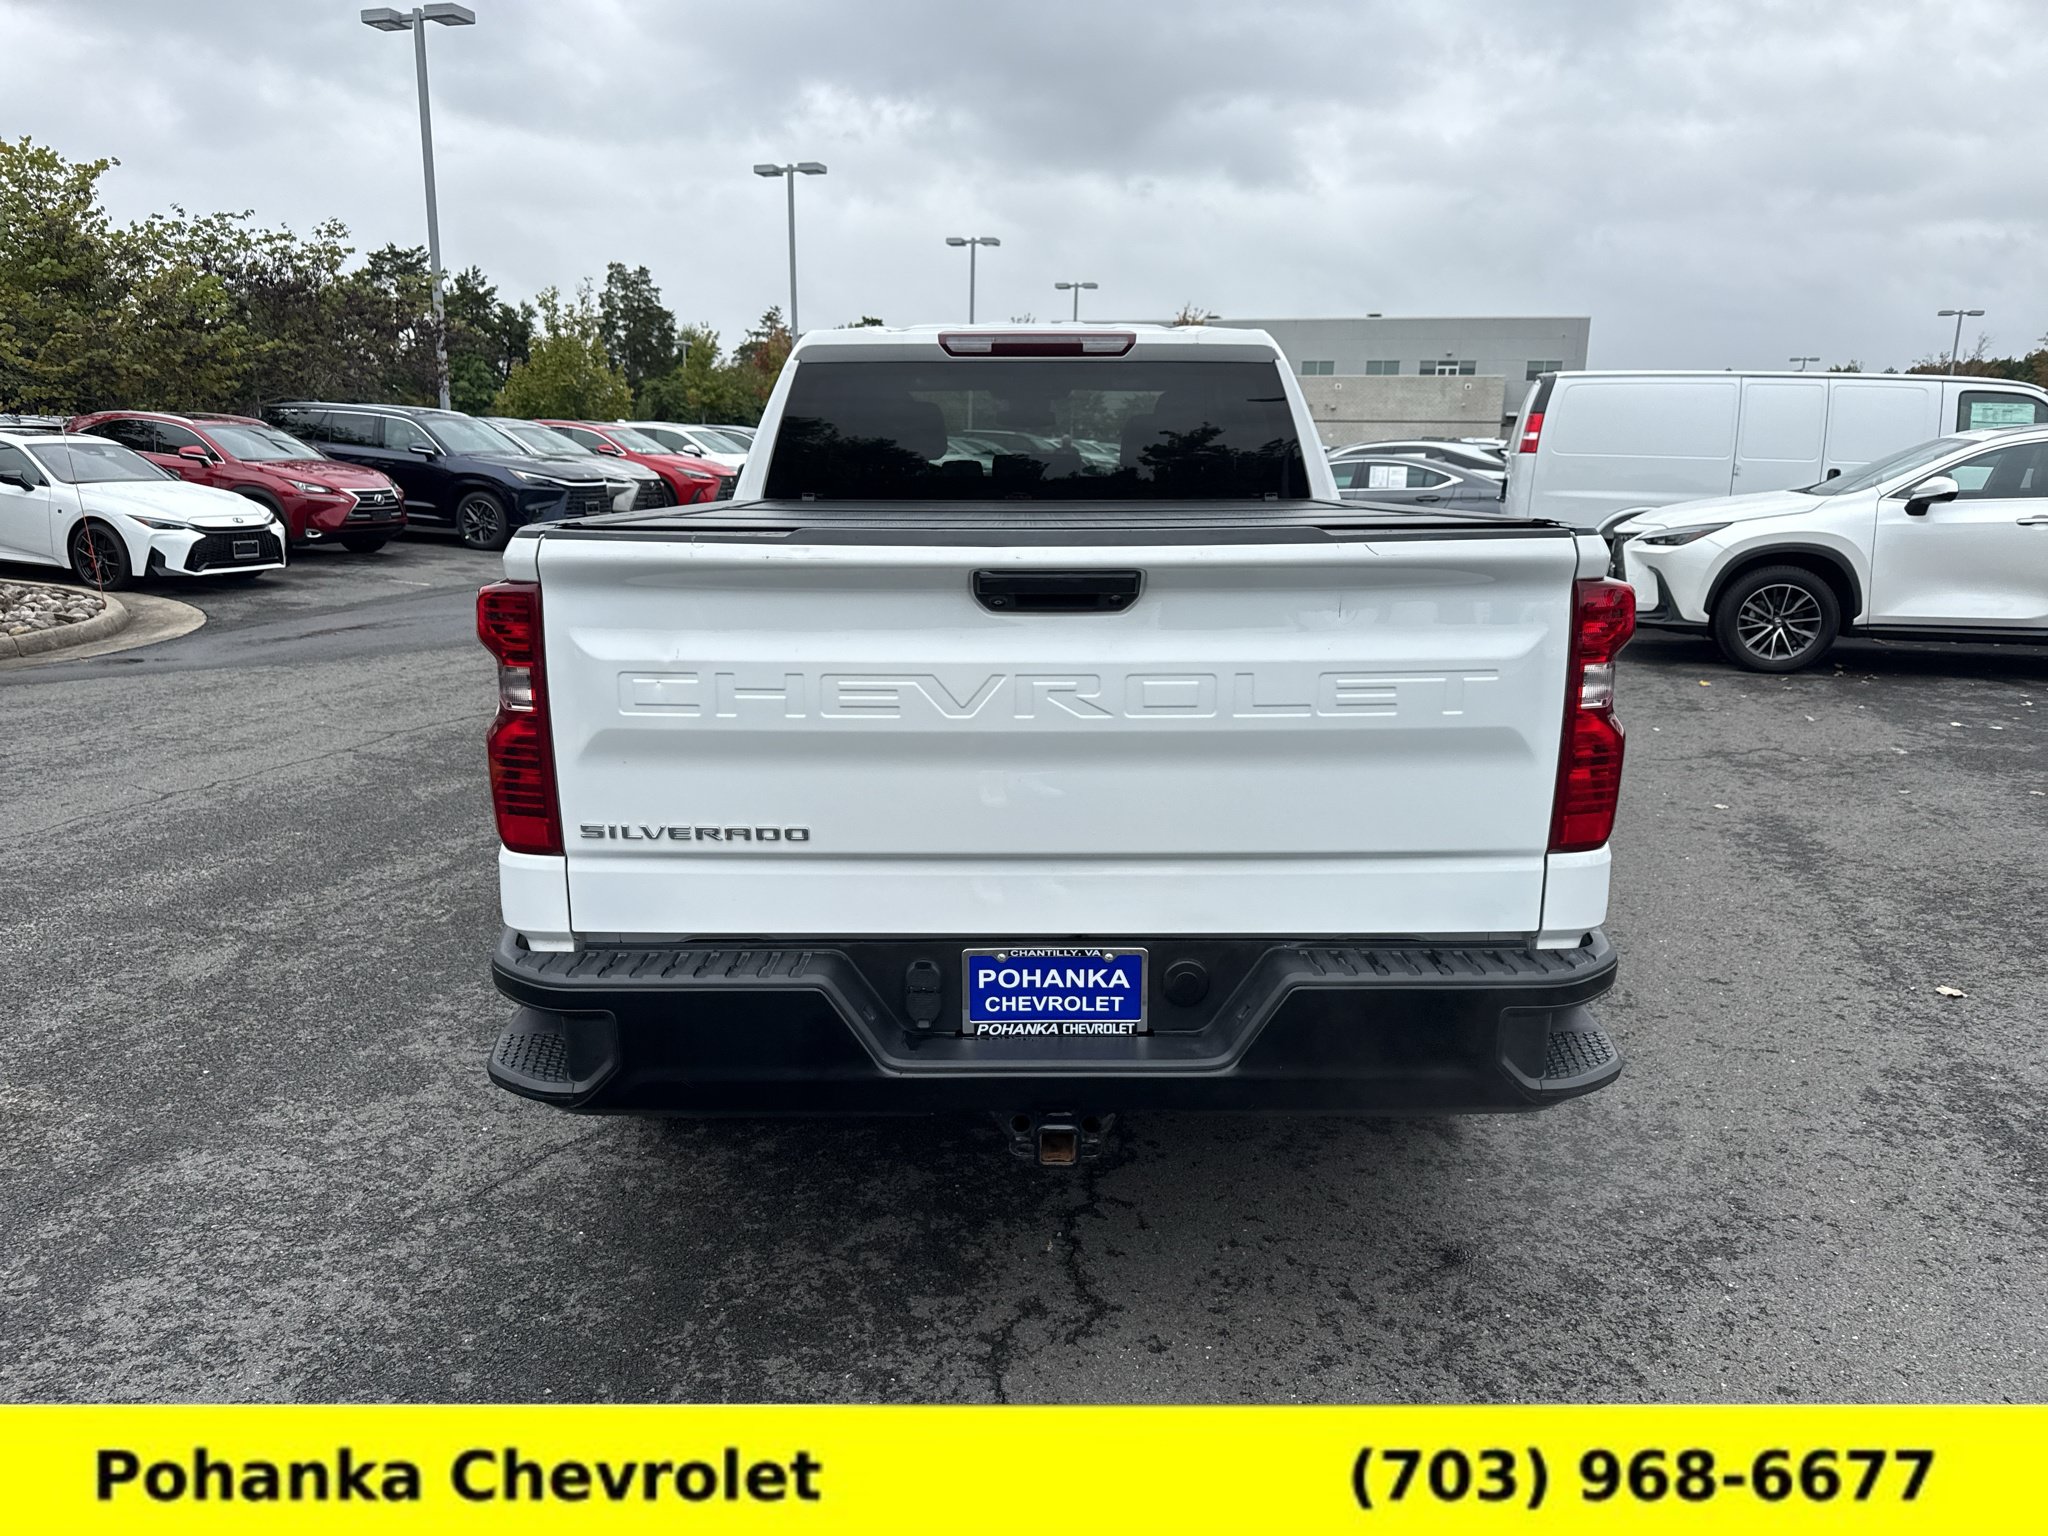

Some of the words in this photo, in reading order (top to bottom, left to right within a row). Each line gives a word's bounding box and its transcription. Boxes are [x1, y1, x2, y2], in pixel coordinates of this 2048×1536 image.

[617, 668, 1499, 719] CHEVROLET
[579, 822, 811, 843] SILVERADO
[1084, 949, 1101, 957] VA
[978, 969, 1130, 989] POHANKA
[985, 996, 1124, 1012] CHEVROLET
[976, 1023, 1059, 1036] POHANKA
[1062, 1022, 1135, 1035] CHEVROLET
